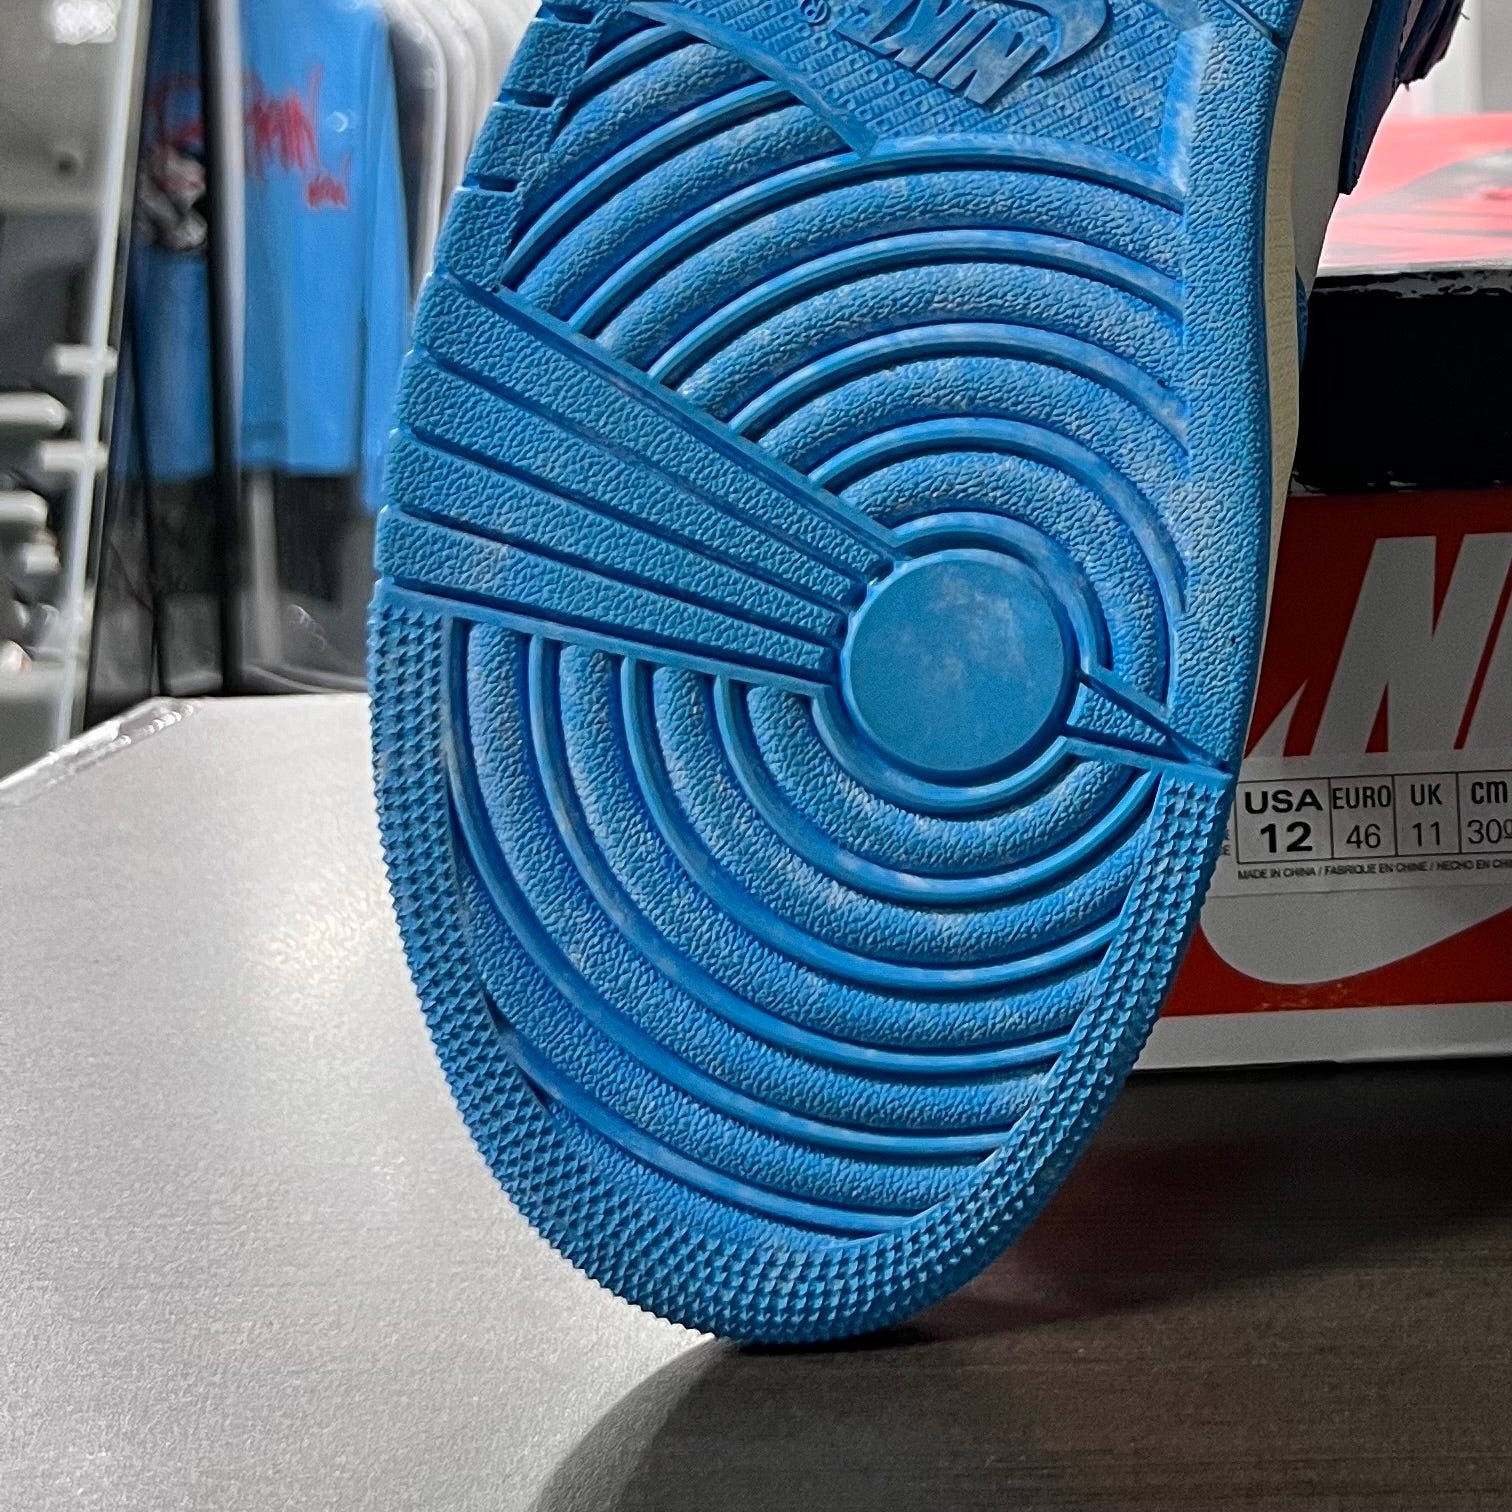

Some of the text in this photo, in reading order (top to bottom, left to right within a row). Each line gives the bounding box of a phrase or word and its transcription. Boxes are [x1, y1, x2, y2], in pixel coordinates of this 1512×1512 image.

[1244, 789, 1323, 814] USA
[1333, 785, 1391, 810] EURO
[1410, 783, 1443, 806] UK
[1471, 780, 1508, 805] cm
[1260, 821, 1313, 853] 12
[1346, 823, 1381, 849] 46
[1412, 821, 1440, 847] 11
[1238, 869, 1268, 880] MADE
[1270, 868, 1281, 878] IN
[1283, 867, 1316, 878] CHINA
[1379, 863, 1393, 873] EN
[1476, 859, 1490, 870] EN
